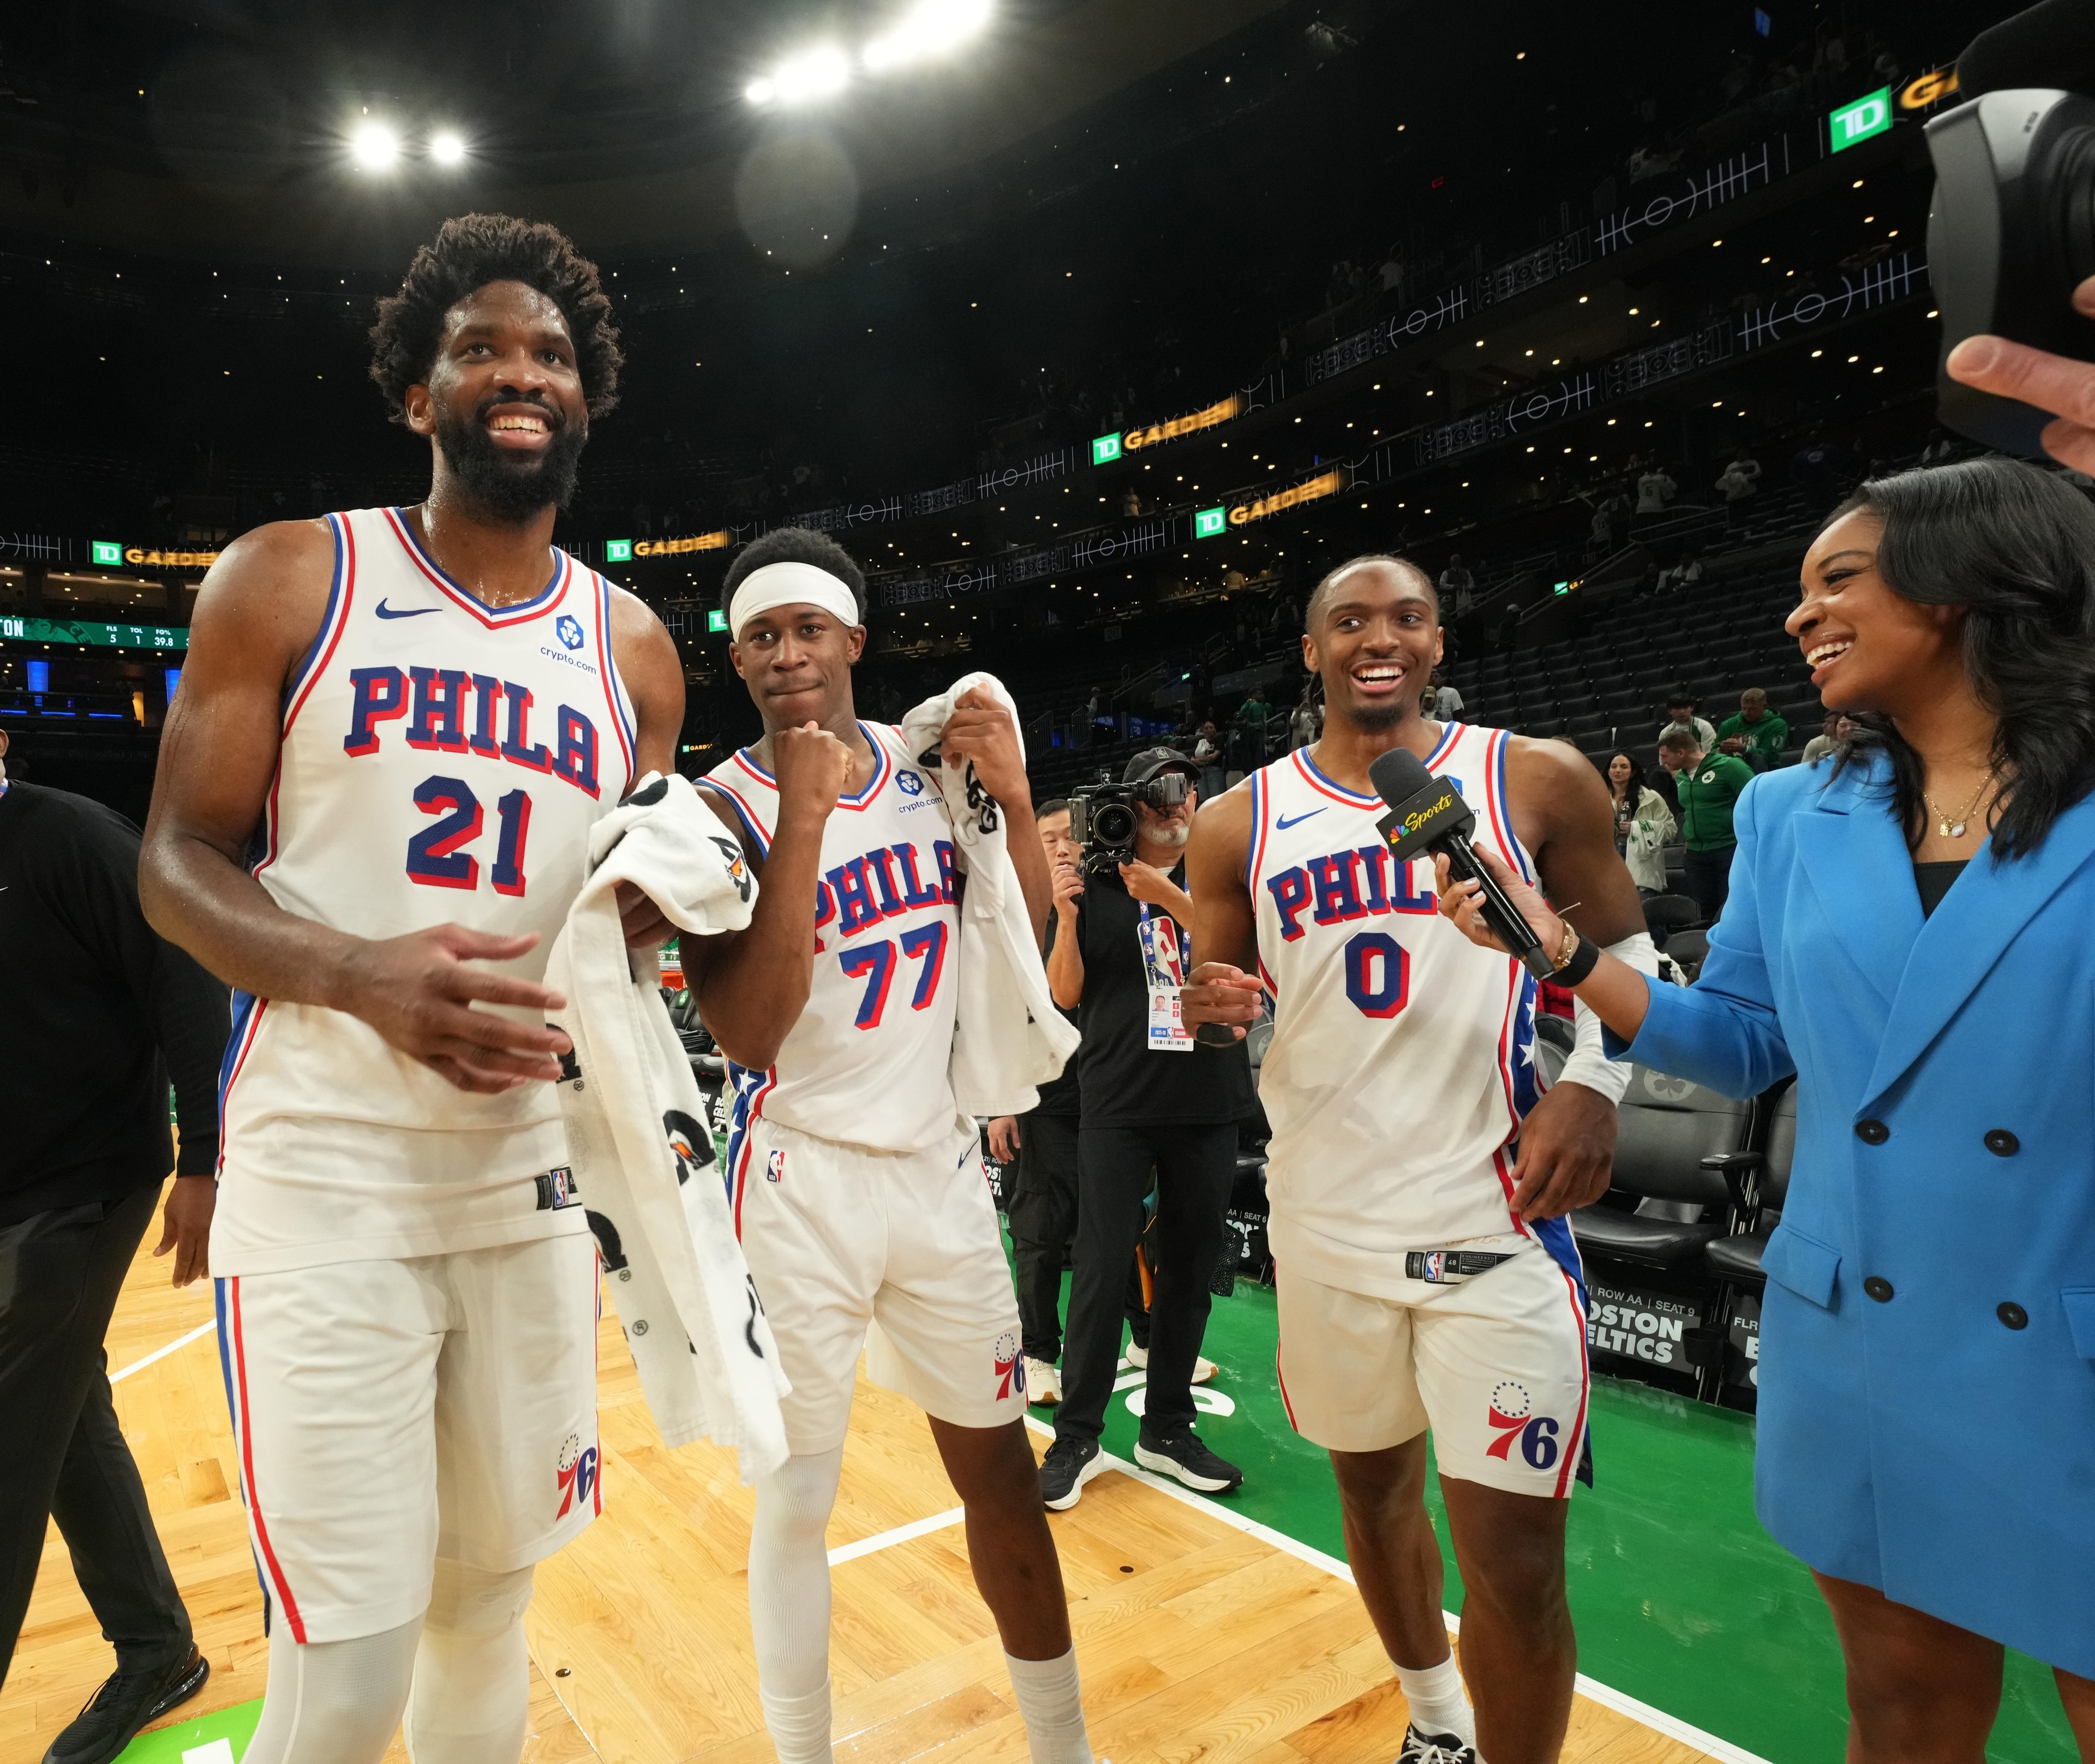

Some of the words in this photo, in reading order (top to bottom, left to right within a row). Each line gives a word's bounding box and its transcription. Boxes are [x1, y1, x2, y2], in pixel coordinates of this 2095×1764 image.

[1835, 99, 1885, 140] TD
[1095, 439, 1117, 458] TD
[1199, 512, 1222, 531] TD
[95, 545, 119, 560] TD
[608, 543, 628, 558] TD
[110, 634, 116, 643] 5
[136, 636, 140, 644] 1
[154, 637, 173, 647] 39.8
[540, 646, 596, 675] crypto.com
[343, 666, 601, 801] PHILA
[898, 796, 943, 814] crypto.com
[1405, 794, 1452, 832] Sports
[405, 775, 532, 896] 21
[1267, 844, 1441, 943] PHIL
[838, 920, 948, 1031] 77
[1345, 932, 1410, 1019] 0
[1244, 1211, 1261, 1222] SEAT
[1597, 1287, 1625, 1301] ROW
[1626, 1294, 1643, 1305] AA
[1655, 1300, 1685, 1315] SEAT
[1687, 1307, 1695, 1317] 9
[1734, 1317, 1758, 1331] FLR
[995, 1348, 1025, 1402] 76
[1486, 1404, 1559, 1470] 76
[555, 1447, 597, 1522] 76
